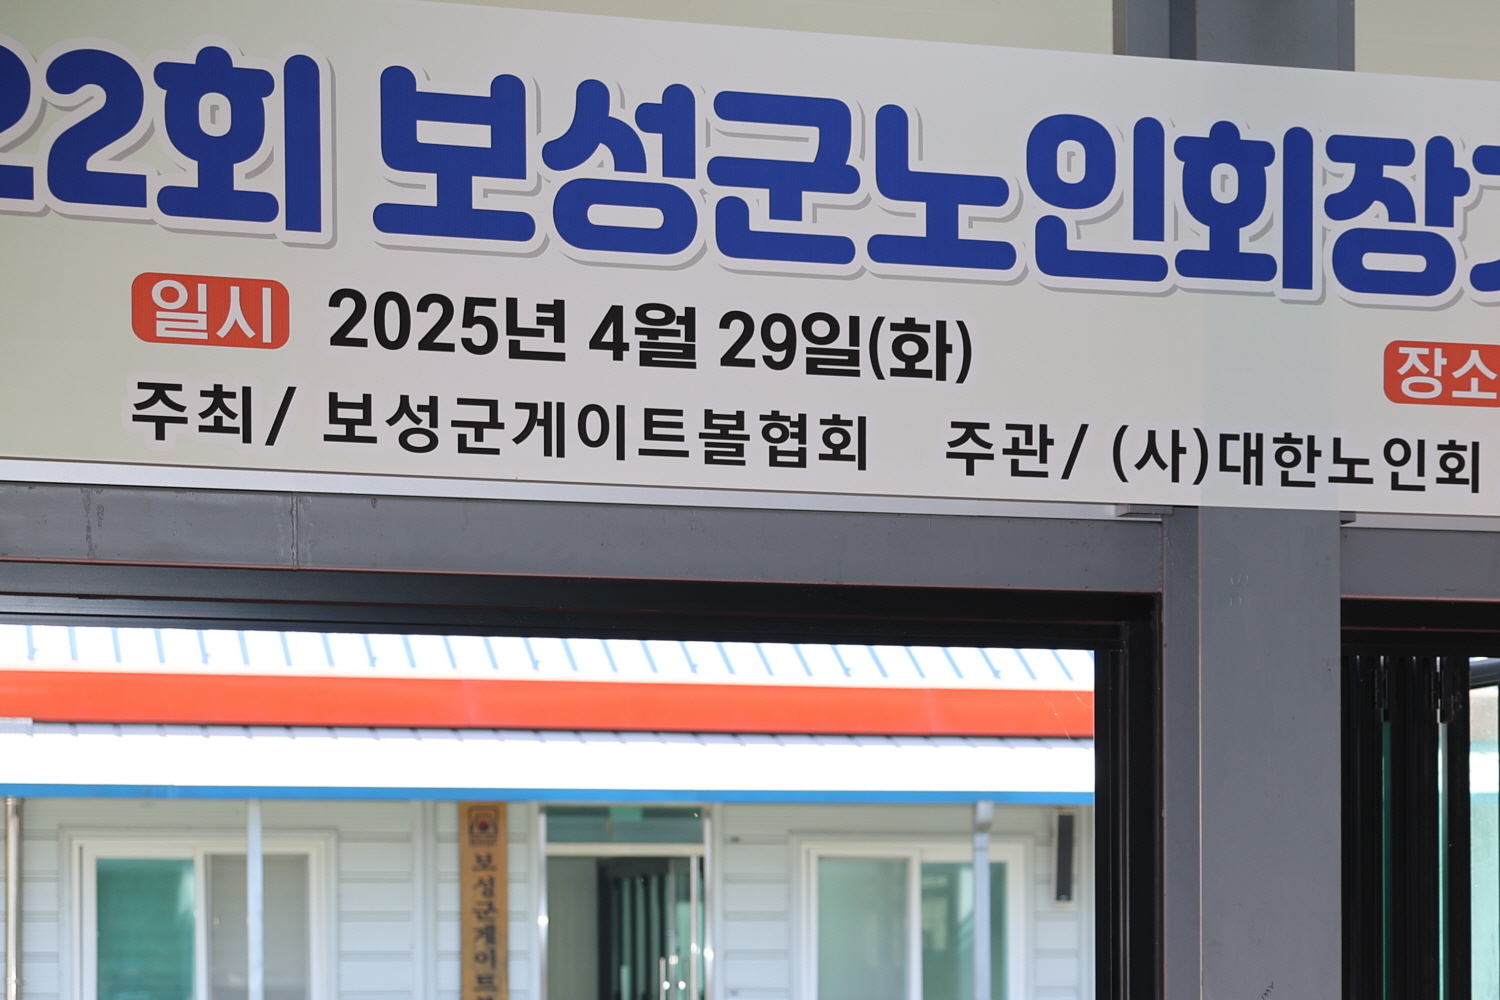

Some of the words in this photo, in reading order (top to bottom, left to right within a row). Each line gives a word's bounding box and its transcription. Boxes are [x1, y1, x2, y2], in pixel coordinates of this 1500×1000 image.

[151, 278, 275, 344] 일시
[328, 288, 566, 362] 2025년
[588, 302, 697, 370] 4월
[718, 310, 972, 384] 29일(화)
[1395, 345, 1499, 401] 장소
[132, 381, 297, 446] 주최/
[323, 391, 867, 472] 보성군게이트볼협회
[945, 421, 1089, 480] 주관/
[1112, 424, 1480, 494] (사)대한노인회
